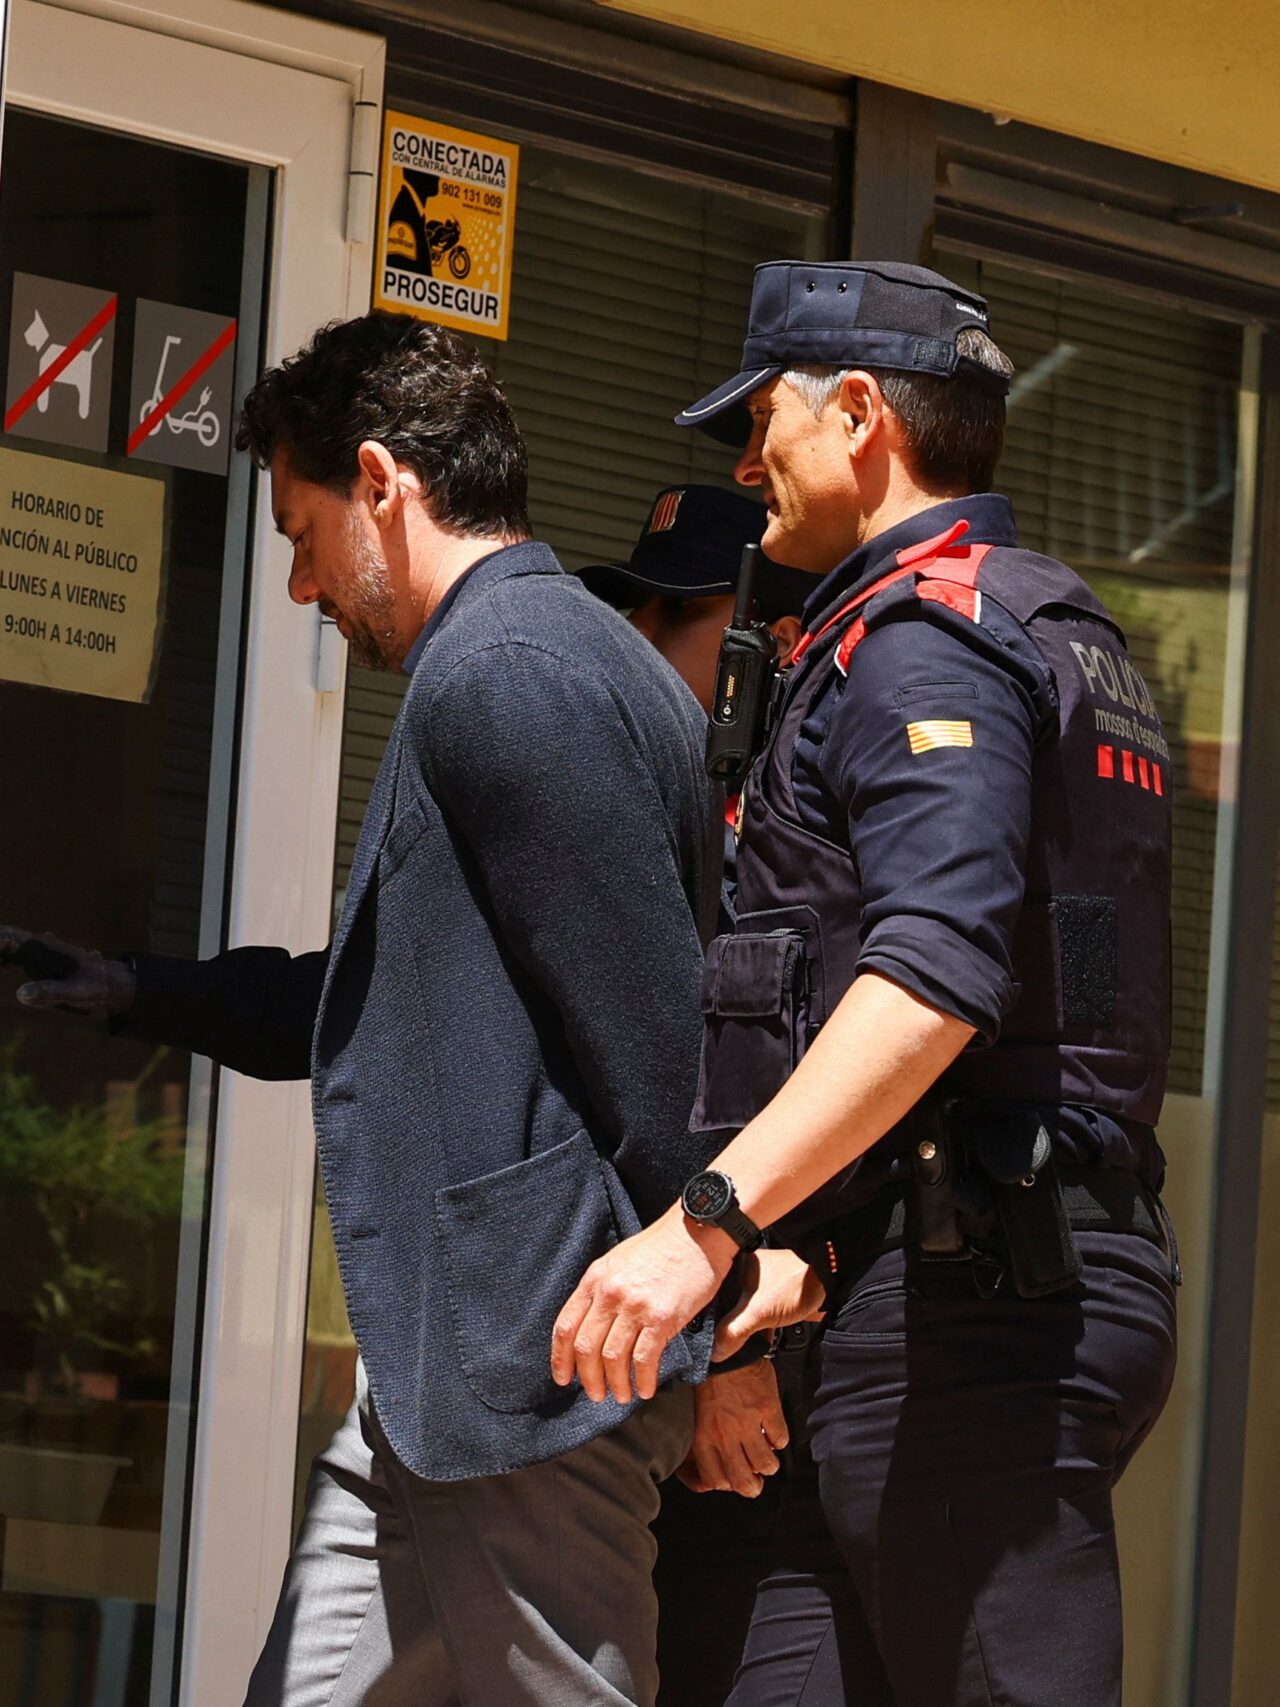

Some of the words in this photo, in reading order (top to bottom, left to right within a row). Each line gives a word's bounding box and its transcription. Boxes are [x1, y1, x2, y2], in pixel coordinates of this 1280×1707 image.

[392, 152, 410, 163] CON
[412, 157, 450, 174] CENTRAL
[452, 167, 463, 177] DE
[464, 170, 506, 188] ALARMAS
[393, 132, 506, 178] CONECTADA
[442, 182, 460, 198] 902
[484, 193, 502, 208] 009
[383, 271, 498, 319] PROSEGUR
[11, 491, 81, 523] HORARIO
[85, 507, 104, 528] DE
[52, 539, 70, 559] AL
[75, 541, 138, 573] PÚBLICO
[0, 570, 47, 597] LUNES
[50, 581, 61, 600] A
[66, 583, 127, 613] VIERNES
[5, 614, 46, 640] 9:00H
[50, 624, 61, 643] A
[65, 627, 116, 654] 14:00H
